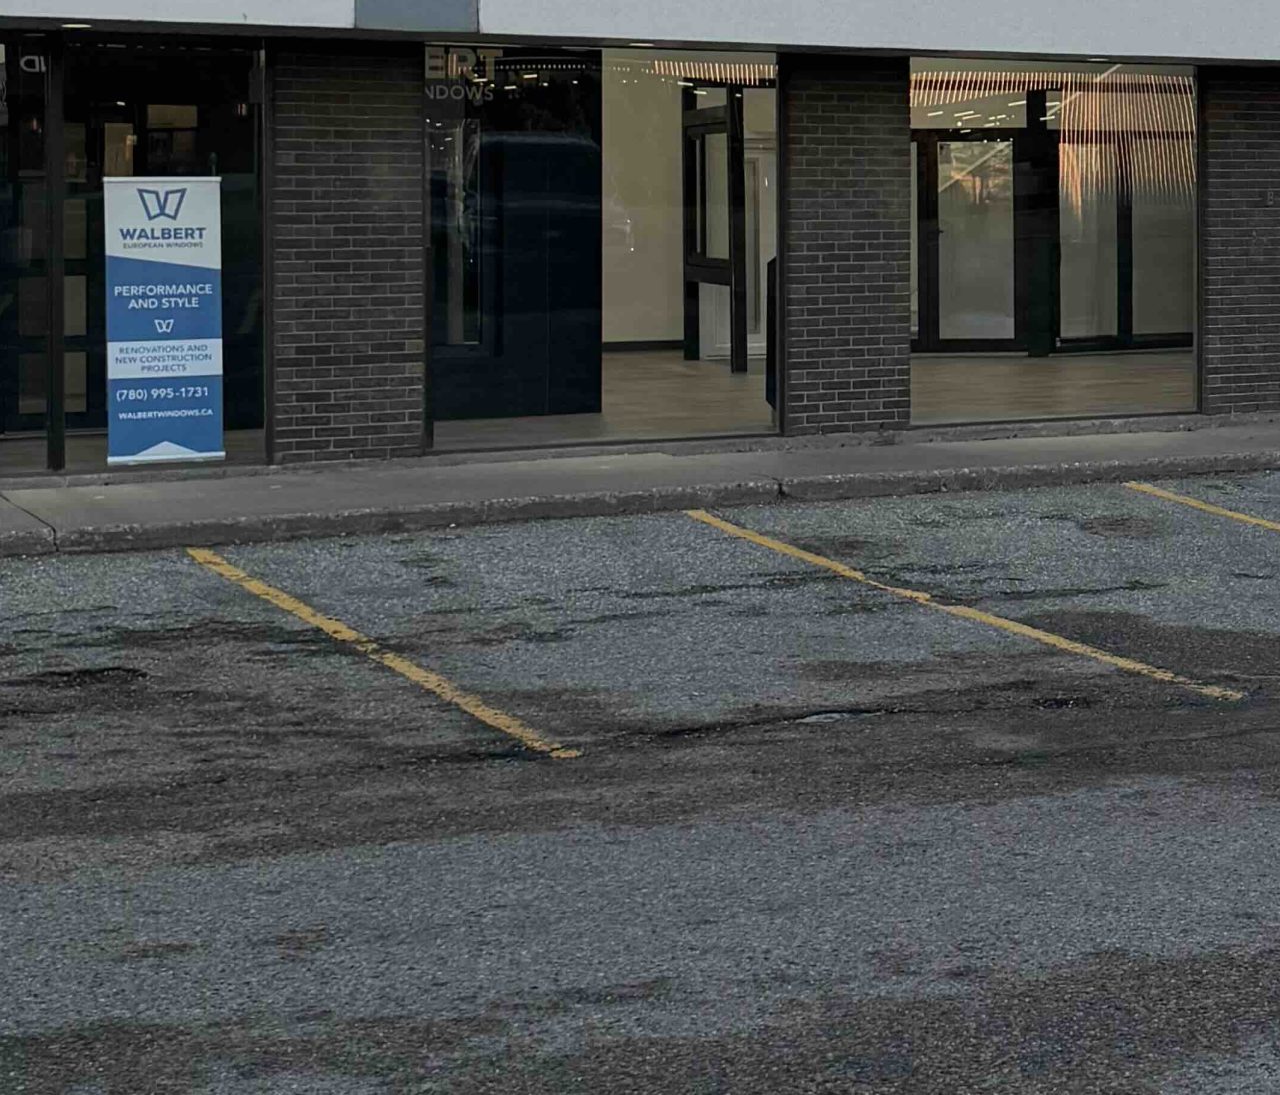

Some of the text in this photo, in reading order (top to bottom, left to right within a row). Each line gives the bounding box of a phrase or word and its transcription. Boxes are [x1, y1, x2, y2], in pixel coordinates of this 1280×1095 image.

[119, 227, 207, 240] WALBERT
[114, 283, 213, 296] PERFORMANCE
[128, 297, 199, 309] AND STYLE
[119, 344, 208, 355] RENOVATIONS AND
[115, 353, 213, 364] NEW CONSTRUCTION
[141, 364, 187, 373] PROJECTS
[116, 387, 208, 402] (780) 995-1731
[118, 408, 214, 420] WALBERTWINDOWS.CA
